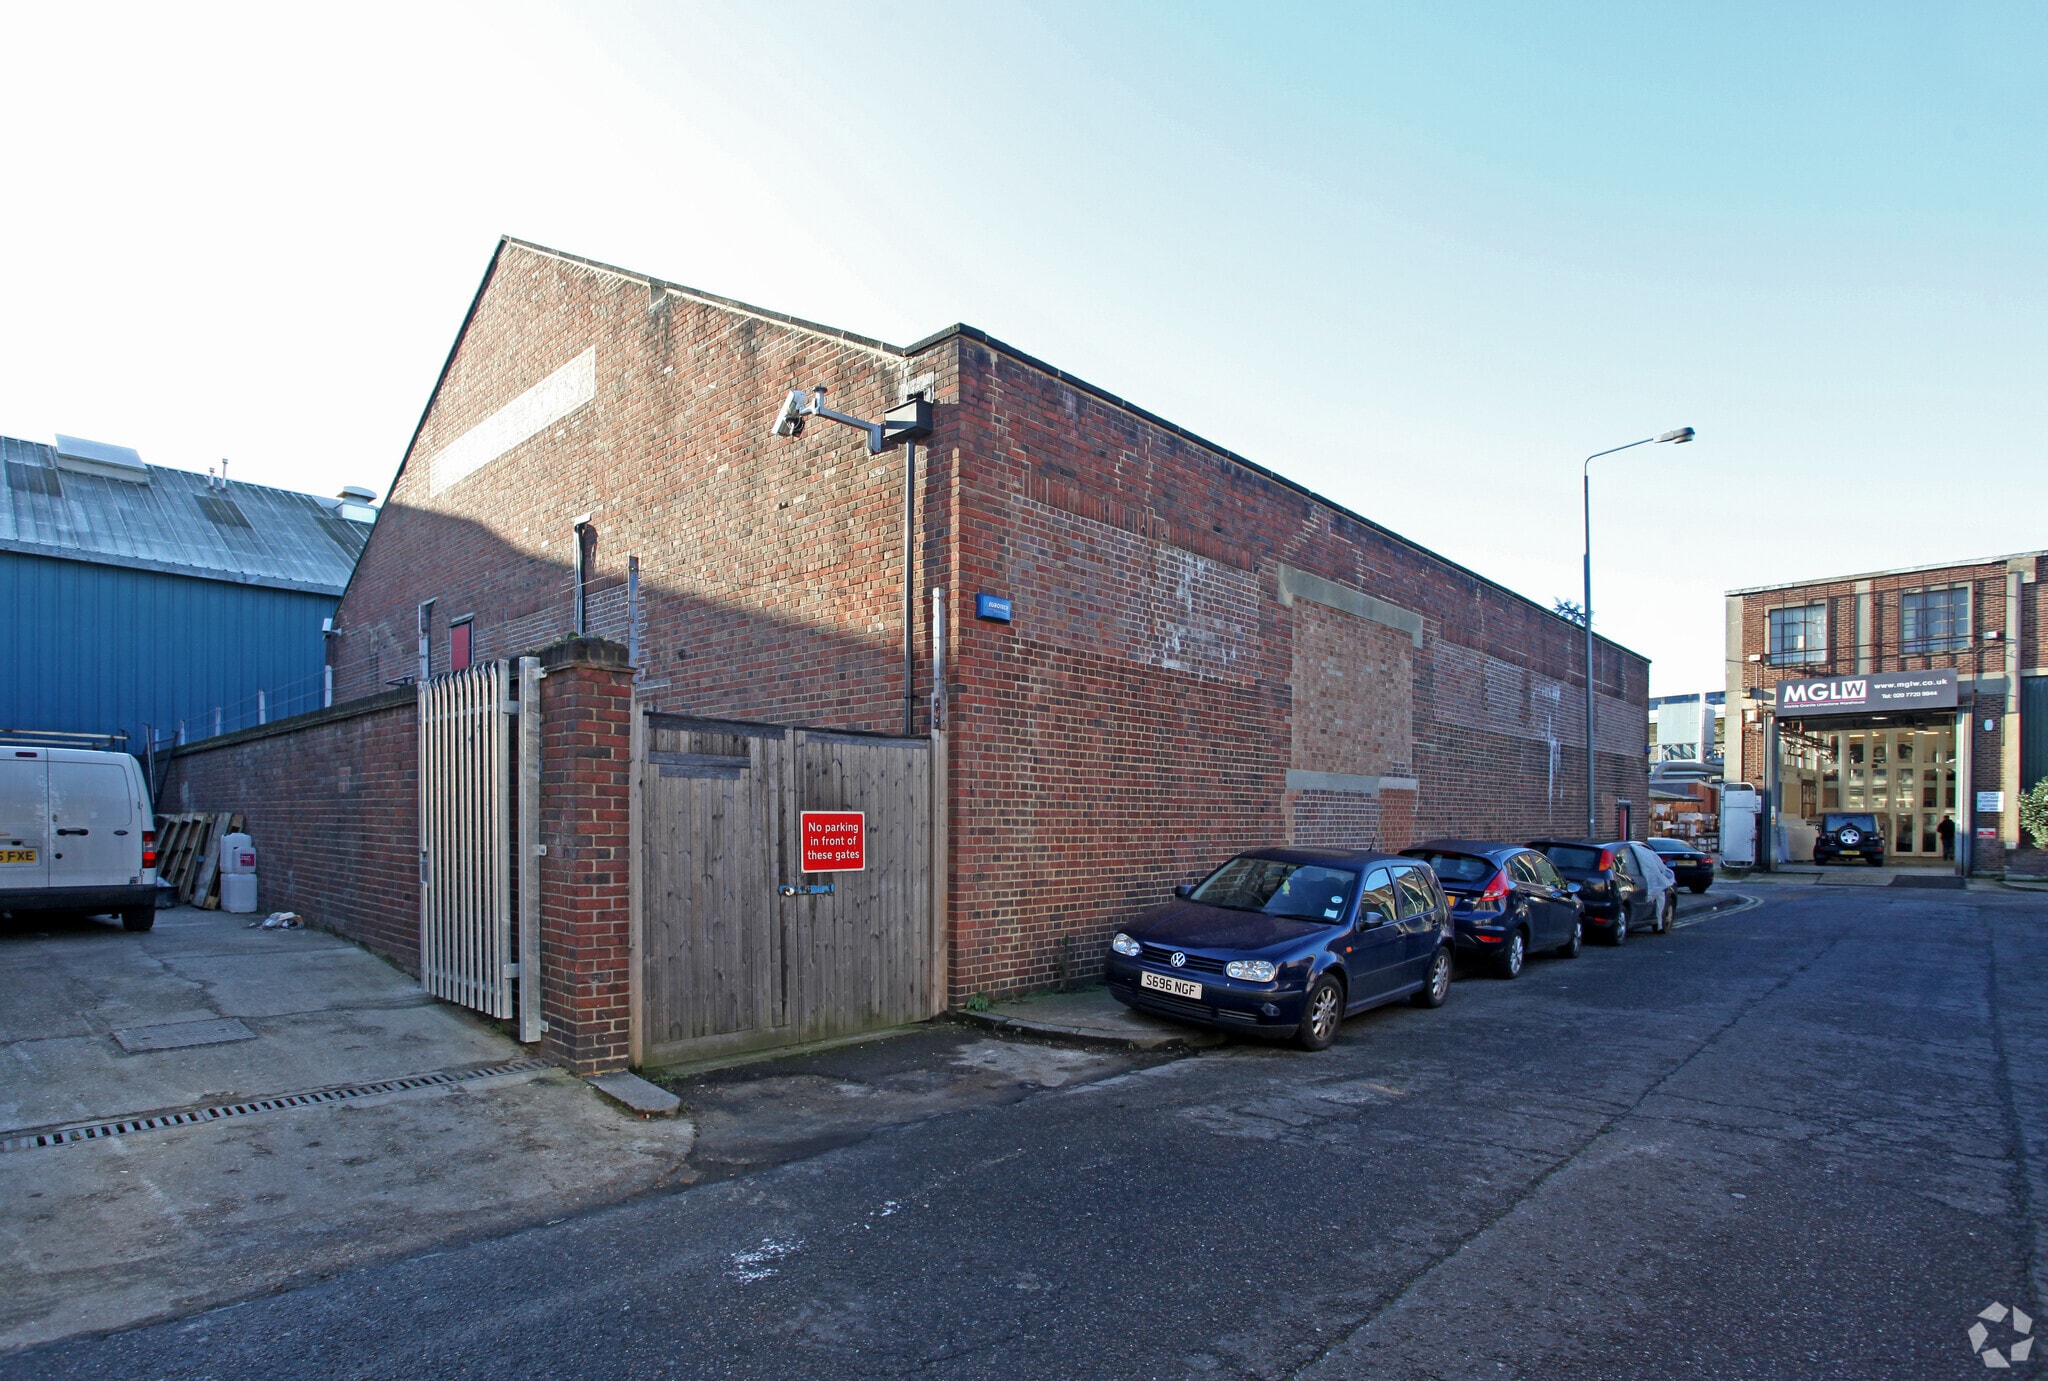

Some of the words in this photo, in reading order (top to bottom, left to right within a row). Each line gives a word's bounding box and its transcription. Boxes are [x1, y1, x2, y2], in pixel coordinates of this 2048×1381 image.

[1873, 678, 1949, 689] www.mglw.co.uk
[1783, 680, 1866, 702] MGLW
[808, 822, 822, 832] No
[825, 822, 859, 834] parking
[810, 836, 819, 846] in
[822, 836, 845, 846] front
[847, 836, 857, 846] of
[7, 850, 34, 862] FXE
[807, 850, 833, 860] these
[835, 850, 860, 861] gates
[1146, 974, 1172, 991] S696
[1174, 981, 1196, 996] NGF
